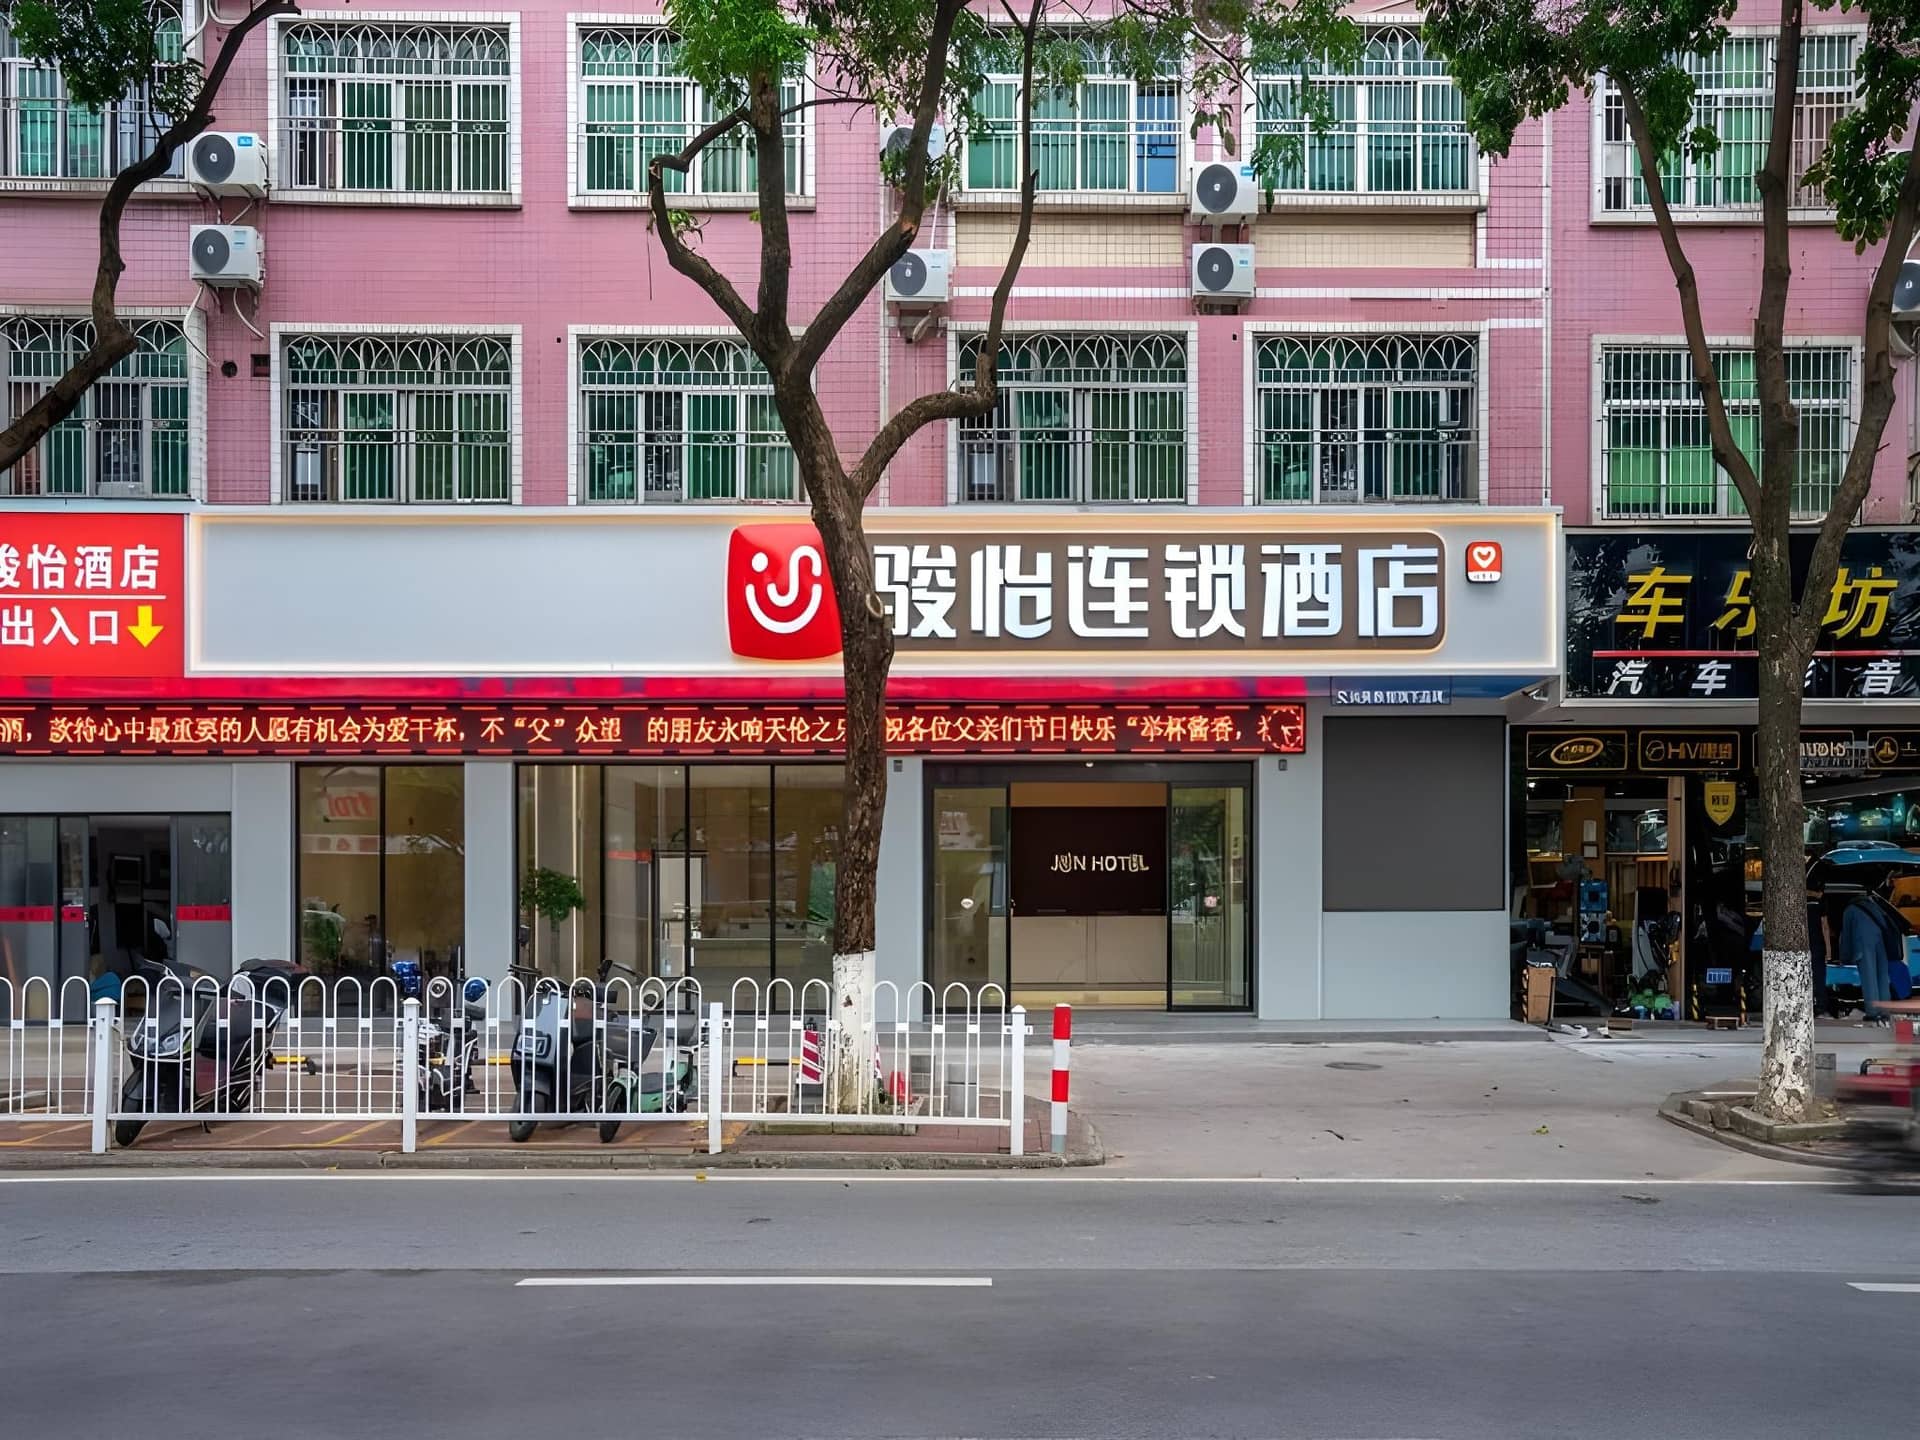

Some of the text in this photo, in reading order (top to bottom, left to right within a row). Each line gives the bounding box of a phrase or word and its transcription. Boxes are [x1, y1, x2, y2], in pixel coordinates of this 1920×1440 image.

[874, 544, 1438, 638] 骏怡连锁酒店
[1, 605, 118, 647] 出入口
[1608, 659, 1900, 696] 汽车音
